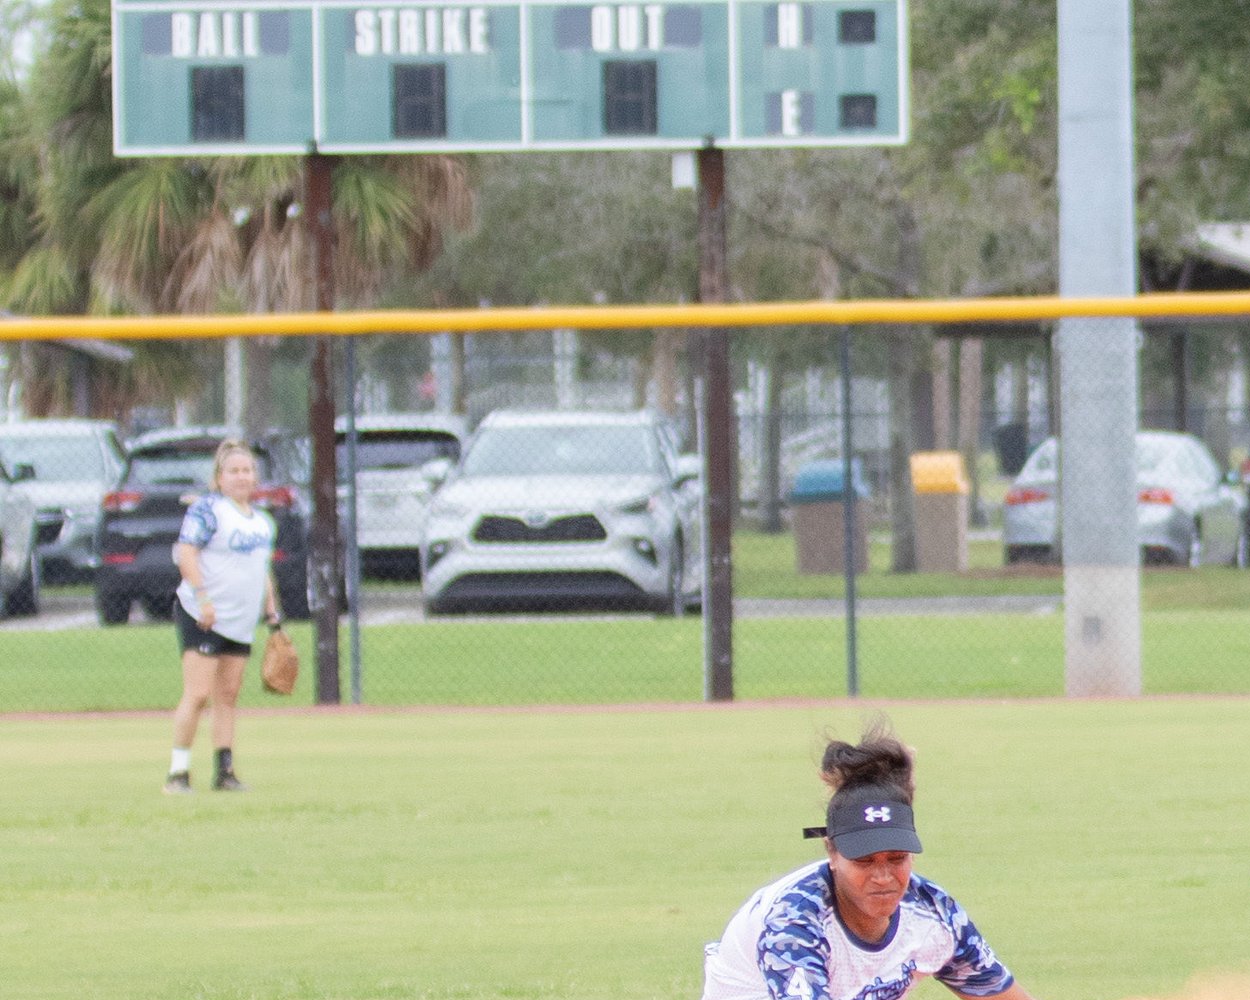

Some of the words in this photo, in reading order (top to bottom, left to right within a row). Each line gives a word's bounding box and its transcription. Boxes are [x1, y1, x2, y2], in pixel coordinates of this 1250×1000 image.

[171, 10, 259, 57] BALL
[354, 7, 489, 55] STRIKE
[590, 4, 662, 51] OUT
[777, 1, 800, 48] H
[781, 89, 800, 137] E
